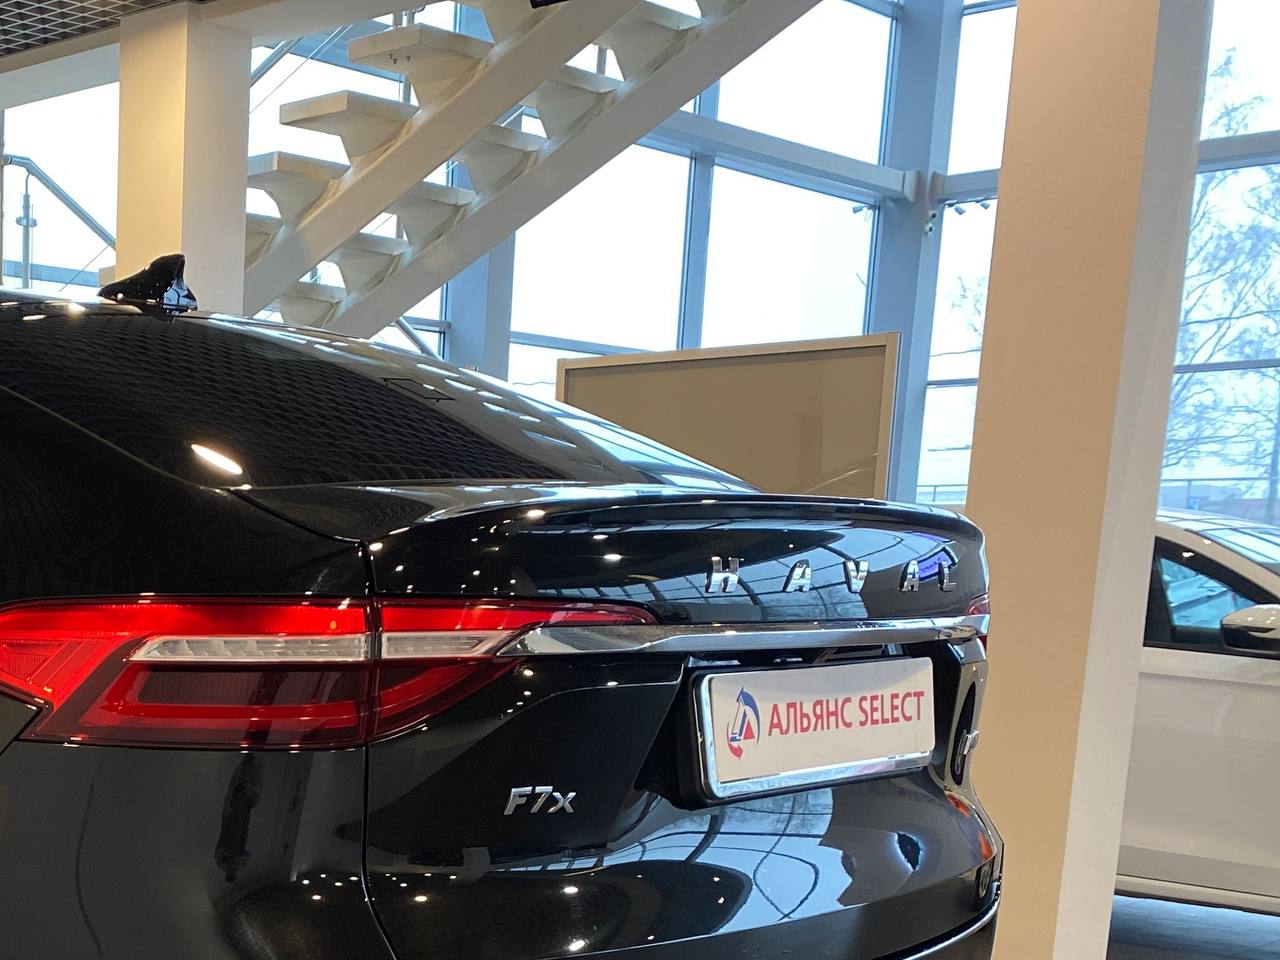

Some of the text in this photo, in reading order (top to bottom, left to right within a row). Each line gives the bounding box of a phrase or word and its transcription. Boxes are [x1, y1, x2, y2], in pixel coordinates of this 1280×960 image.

[704, 556, 957, 593] HAVAL
[768, 691, 925, 737] АЛЬЯНС SELECT
